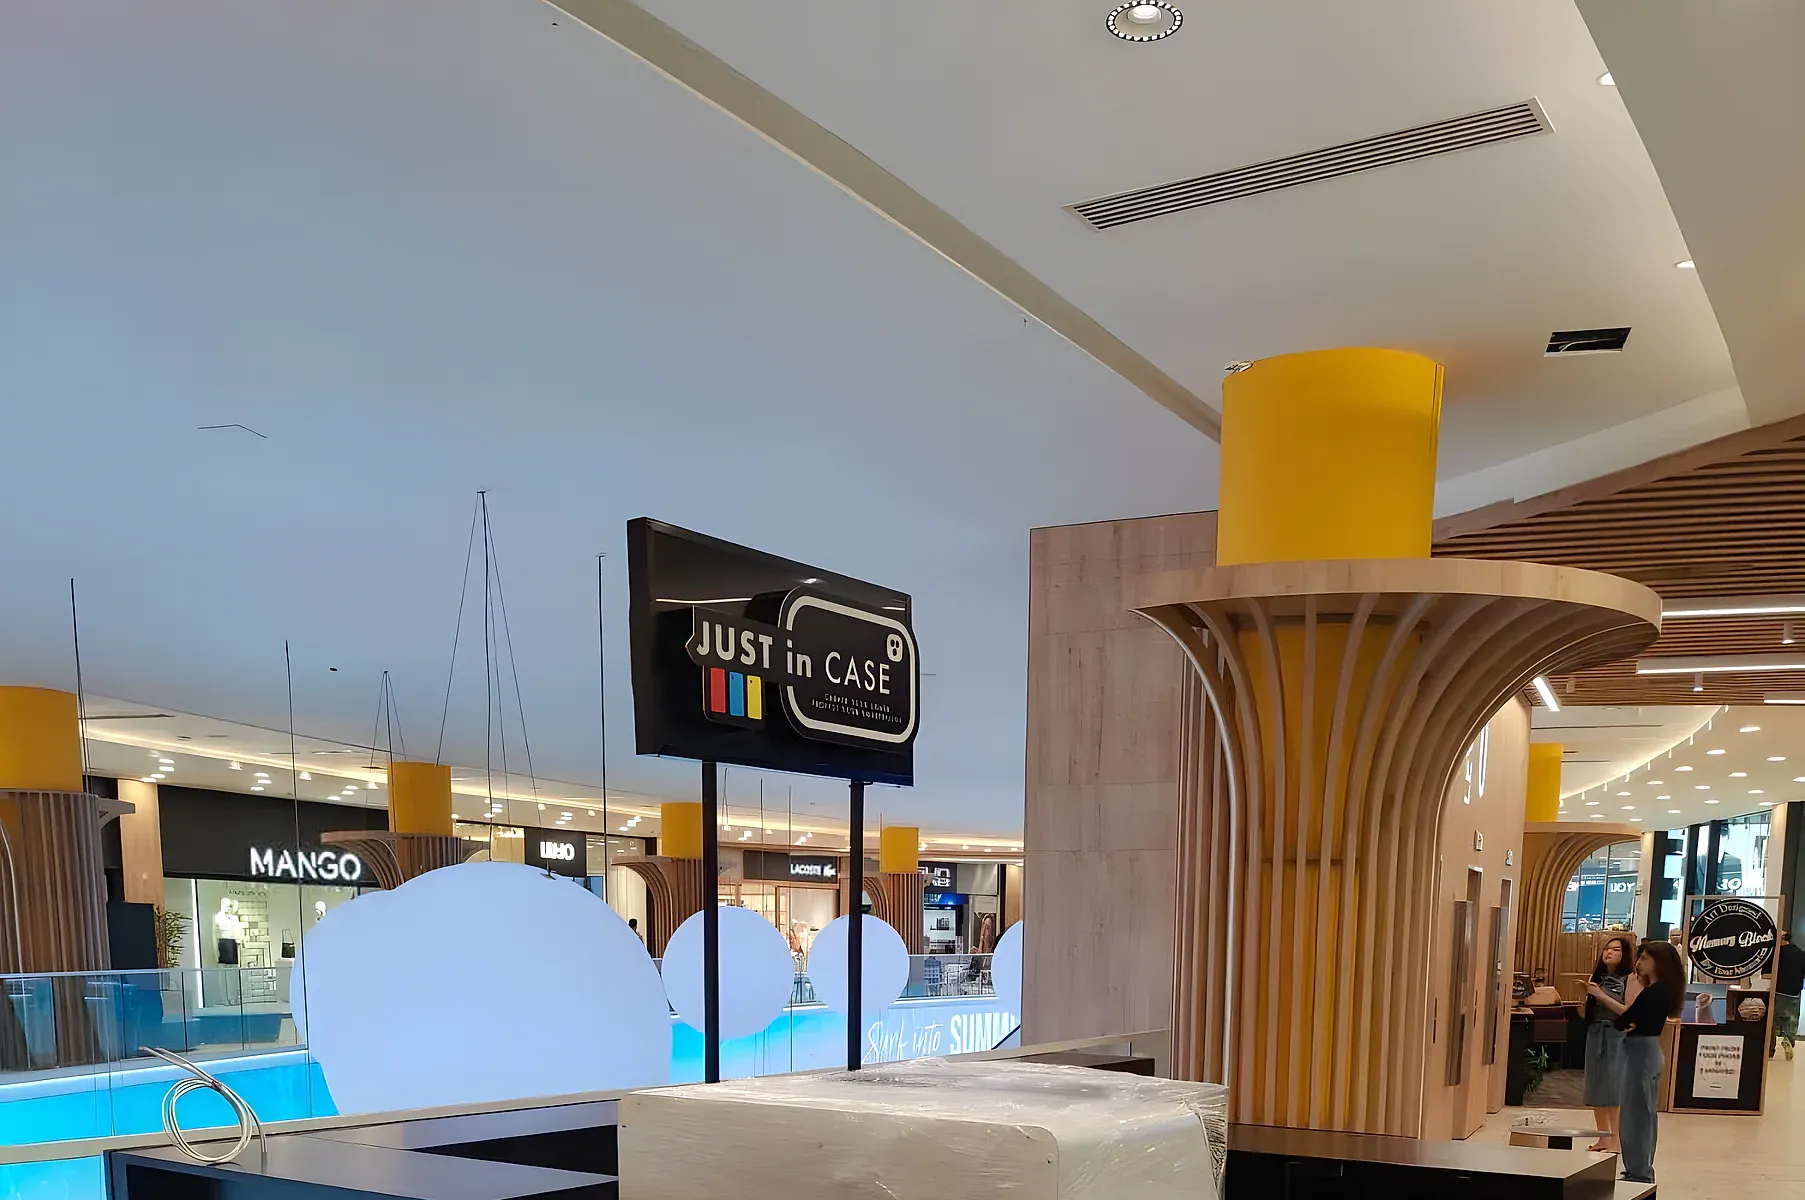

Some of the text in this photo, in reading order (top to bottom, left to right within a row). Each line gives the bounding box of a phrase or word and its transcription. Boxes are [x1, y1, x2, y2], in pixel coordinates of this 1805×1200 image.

[695, 620, 890, 695] JUST in CASE
[250, 846, 361, 880] MANGO
[912, 1020, 944, 1056] into
[949, 1011, 1016, 1055] SUMM
